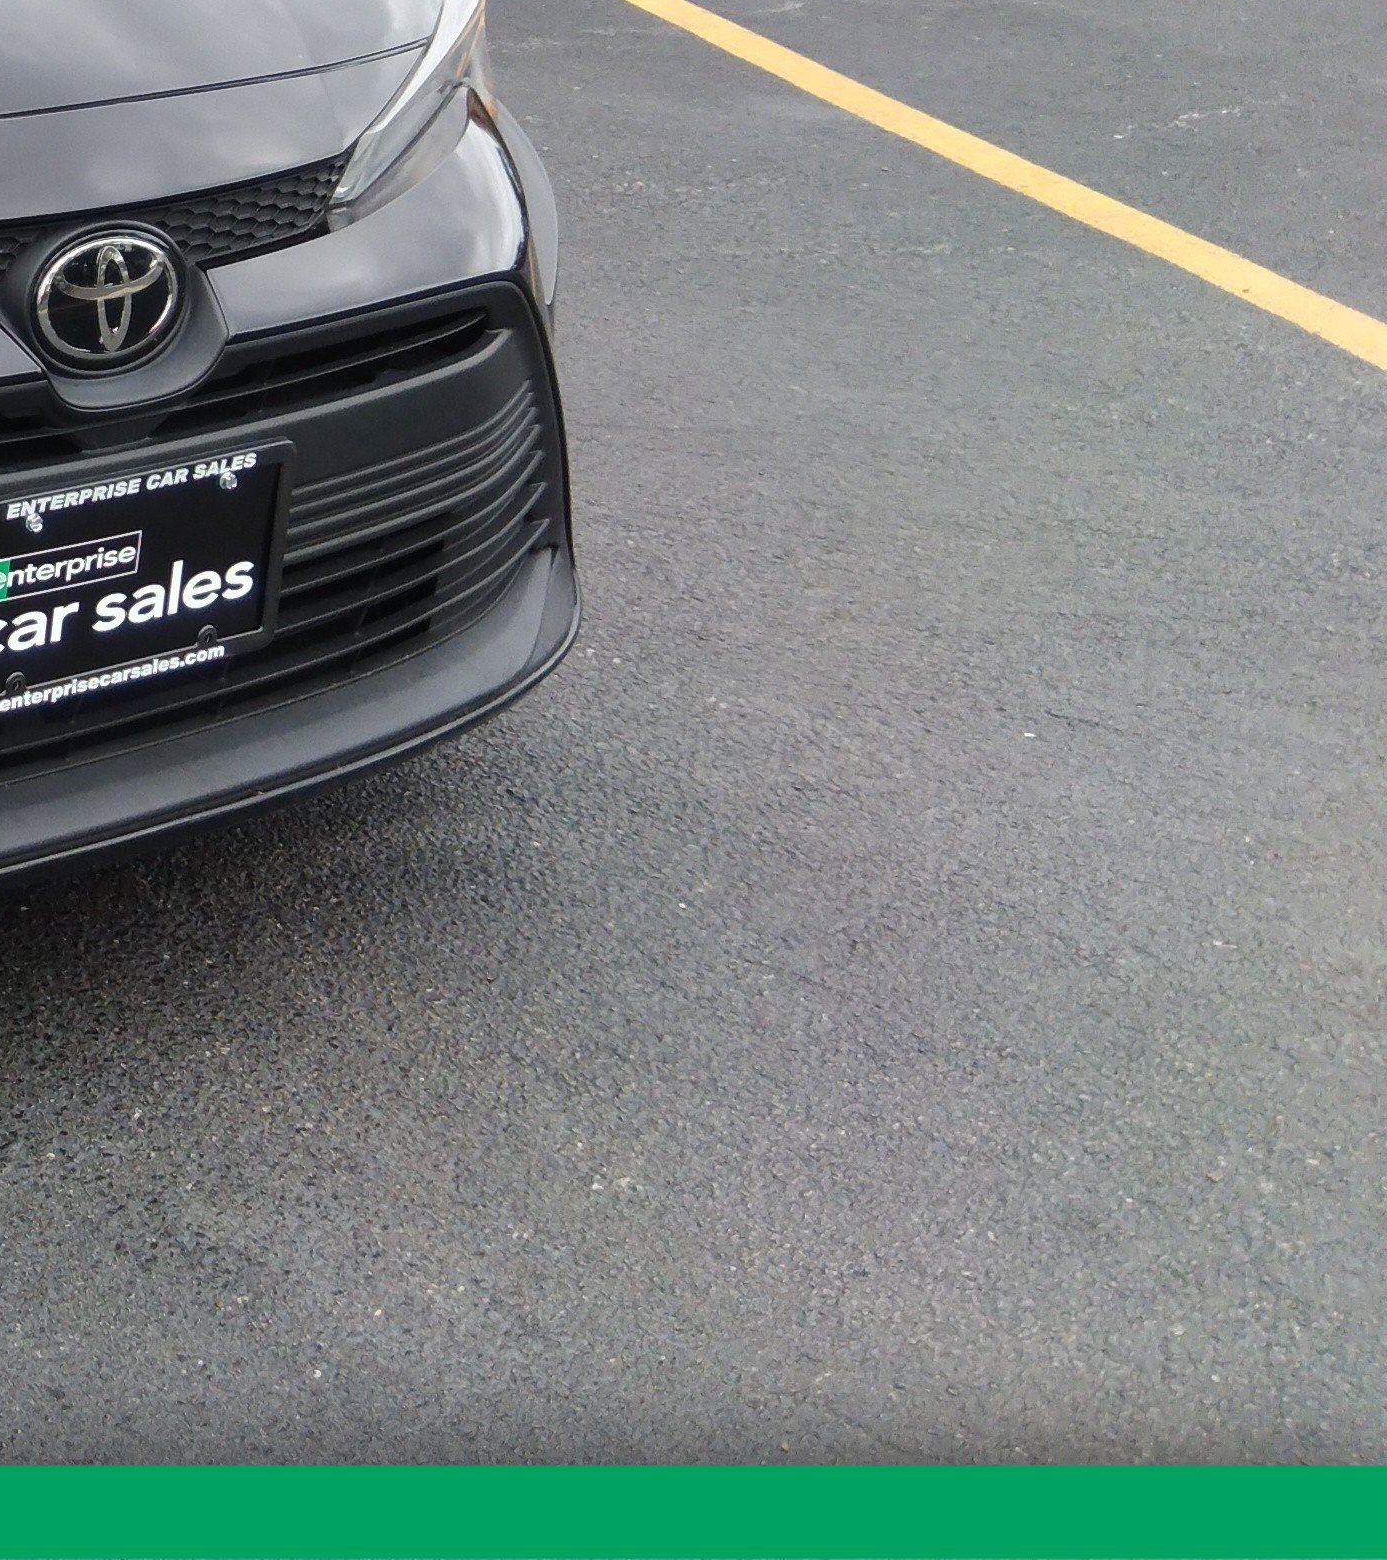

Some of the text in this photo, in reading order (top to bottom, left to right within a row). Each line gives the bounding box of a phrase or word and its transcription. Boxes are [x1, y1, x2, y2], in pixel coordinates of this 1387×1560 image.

[6, 452, 258, 520] ENTERPRISE CAR SALES
[91, 560, 255, 633] sales
